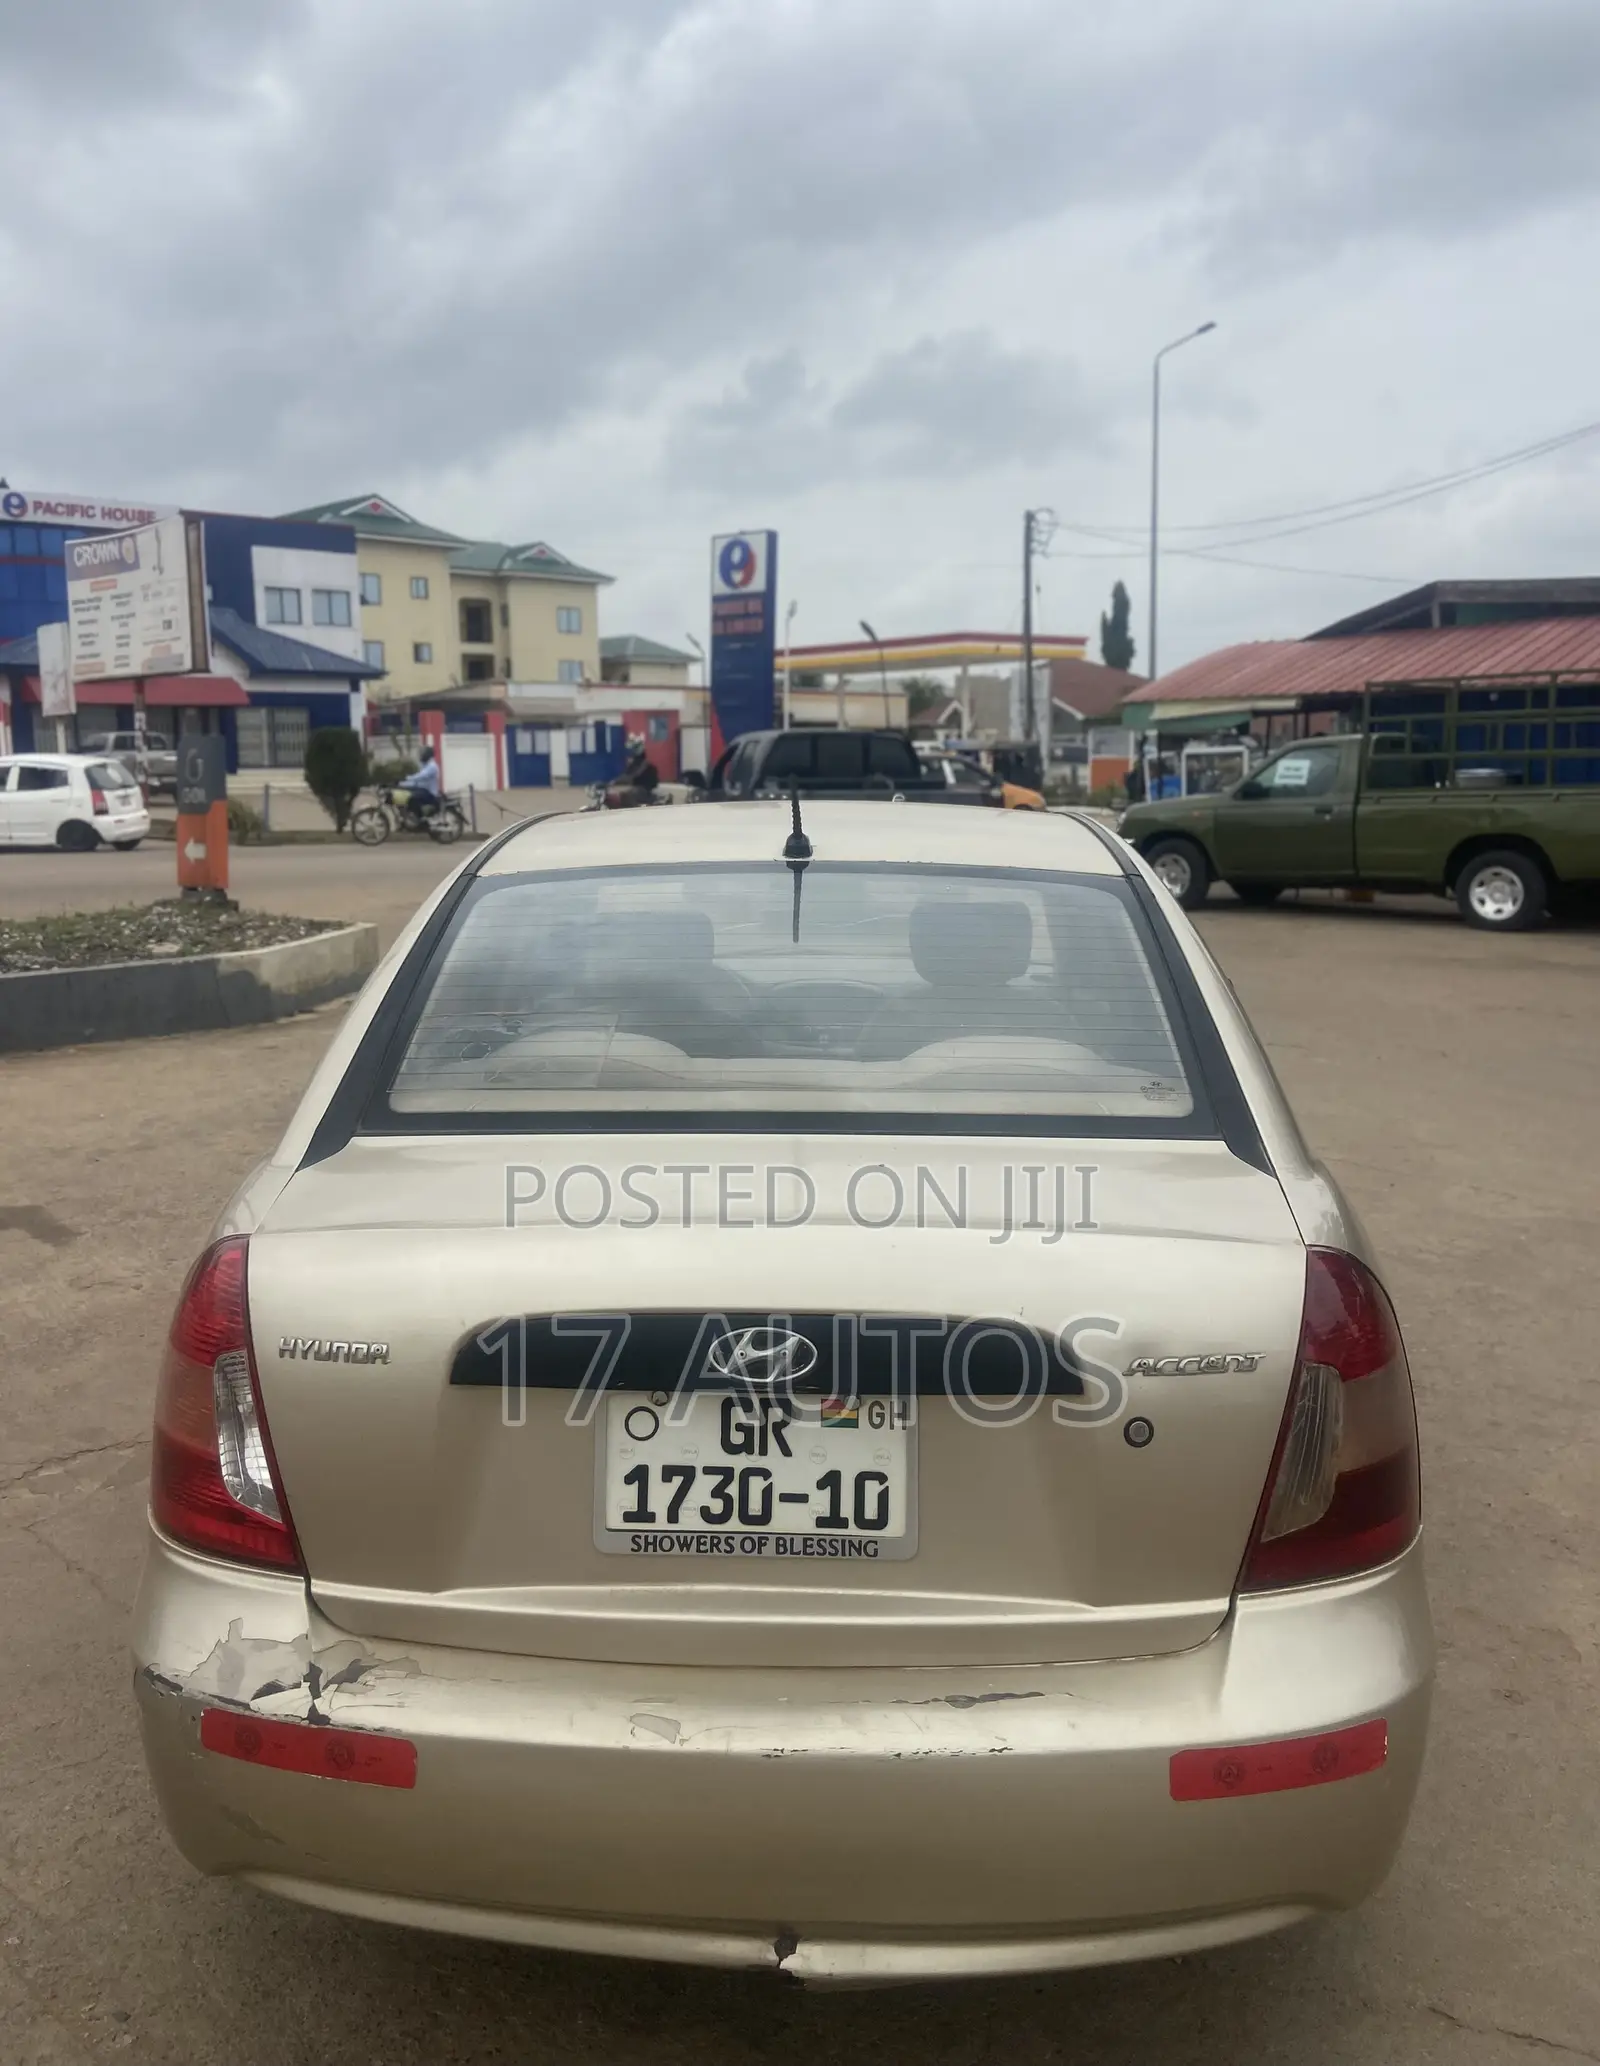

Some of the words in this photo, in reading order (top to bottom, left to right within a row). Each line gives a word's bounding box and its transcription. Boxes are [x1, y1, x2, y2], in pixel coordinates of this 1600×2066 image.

[33, 500, 96, 518] PACIFIC
[101, 506, 156, 525] HOUSE
[74, 538, 120, 567] CROWN
[1122, 1352, 1266, 1376] ACCENT
[720, 1397, 793, 1457] GR
[867, 1400, 907, 1430] GH
[623, 1464, 889, 1530] 1730-10
[631, 1534, 735, 1555] SHOWERS
[740, 1536, 769, 1555] OF
[775, 1537, 879, 1558] BLESSING
